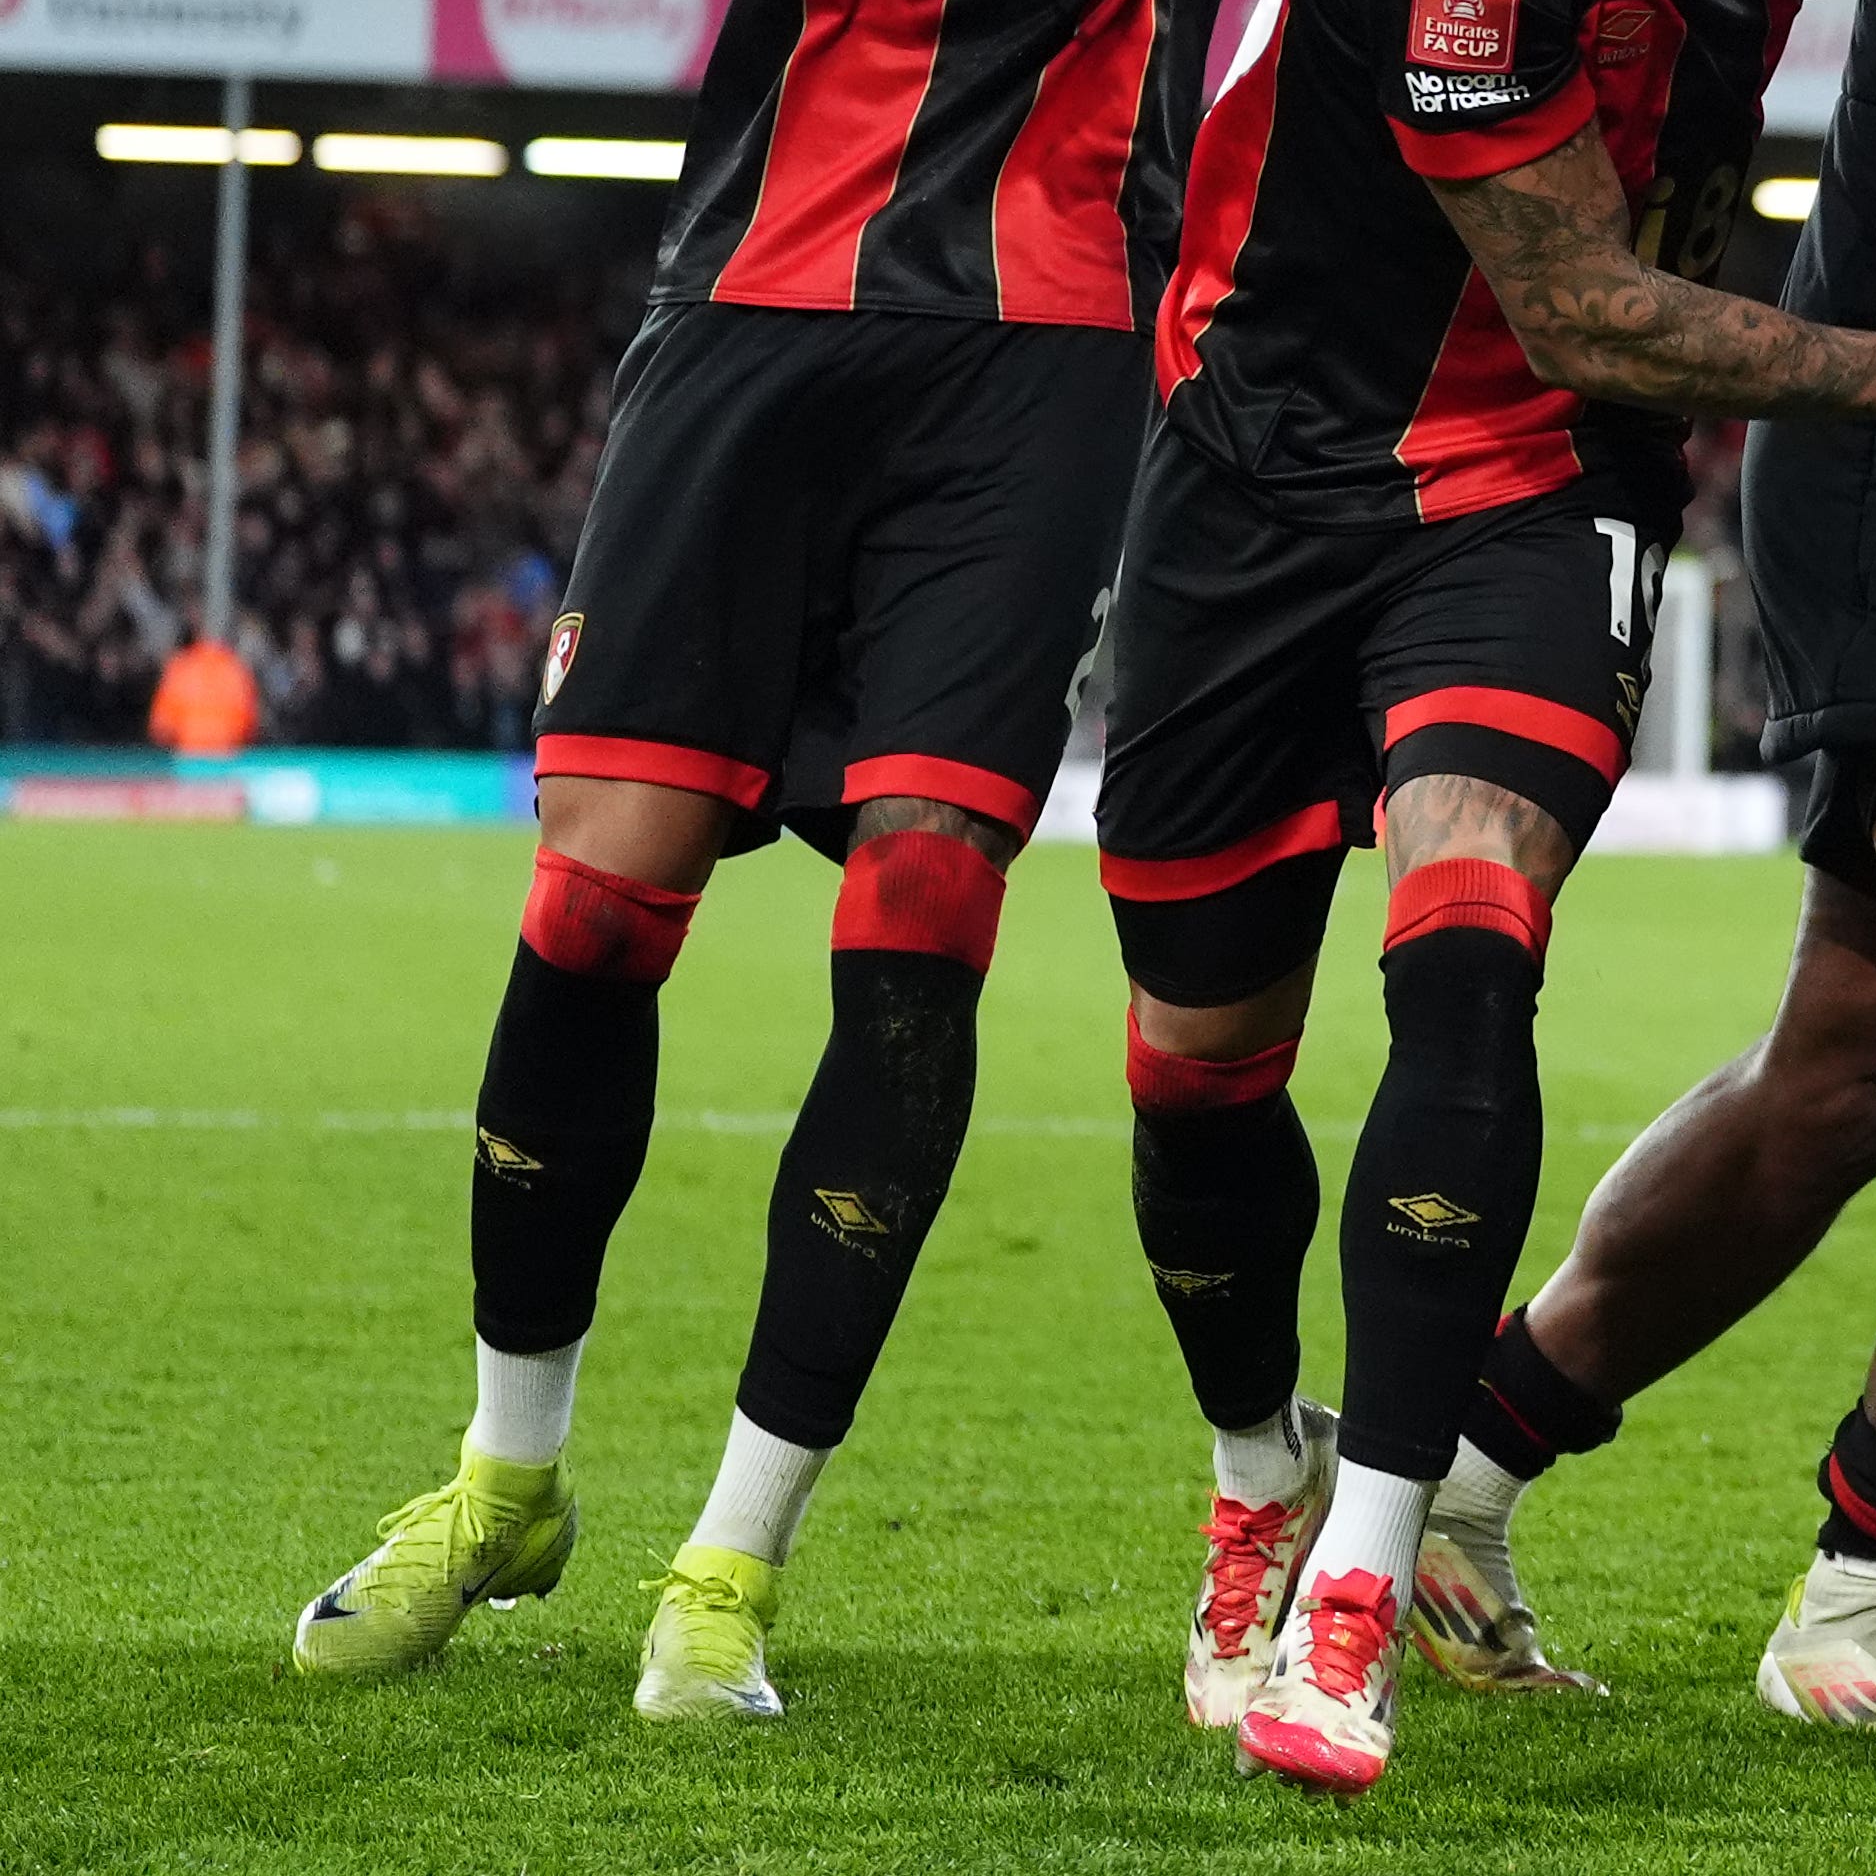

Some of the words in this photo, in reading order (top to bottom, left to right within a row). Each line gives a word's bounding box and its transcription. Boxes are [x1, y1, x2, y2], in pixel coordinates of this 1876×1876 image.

[1425, 16, 1500, 41] Emirates
[1423, 33, 1450, 54] FA
[1452, 38, 1499, 58] CUP
[1405, 71, 1444, 94] No
[1410, 90, 1447, 113] for
